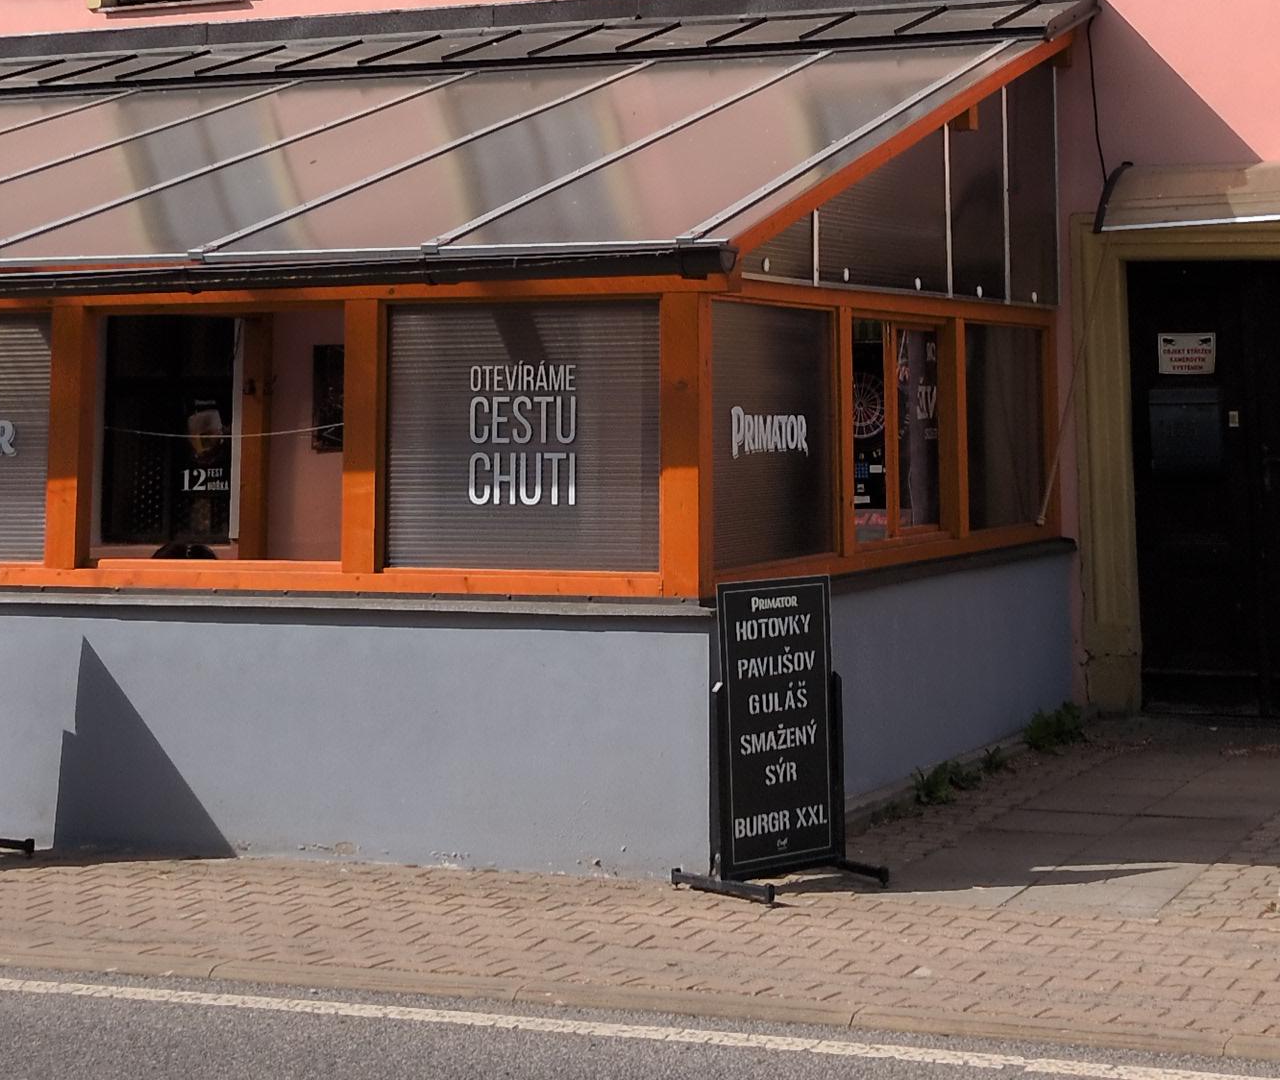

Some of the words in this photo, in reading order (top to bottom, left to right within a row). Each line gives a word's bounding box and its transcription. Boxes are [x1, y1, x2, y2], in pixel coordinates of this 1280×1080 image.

[470, 360, 577, 391] OTEVÍRÁME
[470, 395, 577, 444] CESTU
[731, 406, 809, 459] PRIMATOR
[181, 468, 207, 492] 12
[468, 452, 577, 506] CHUTI
[751, 595, 798, 612] PRIMATOR
[735, 613, 811, 641] HOTOVKY
[737, 646, 816, 680] PAVLIŠOV
[748, 680, 808, 715] GULÁŠ
[740, 718, 817, 755] SMAŽENÝ
[765, 756, 797, 786] SÝR
[734, 809, 790, 839] BURGR
[796, 803, 828, 828] XXL
